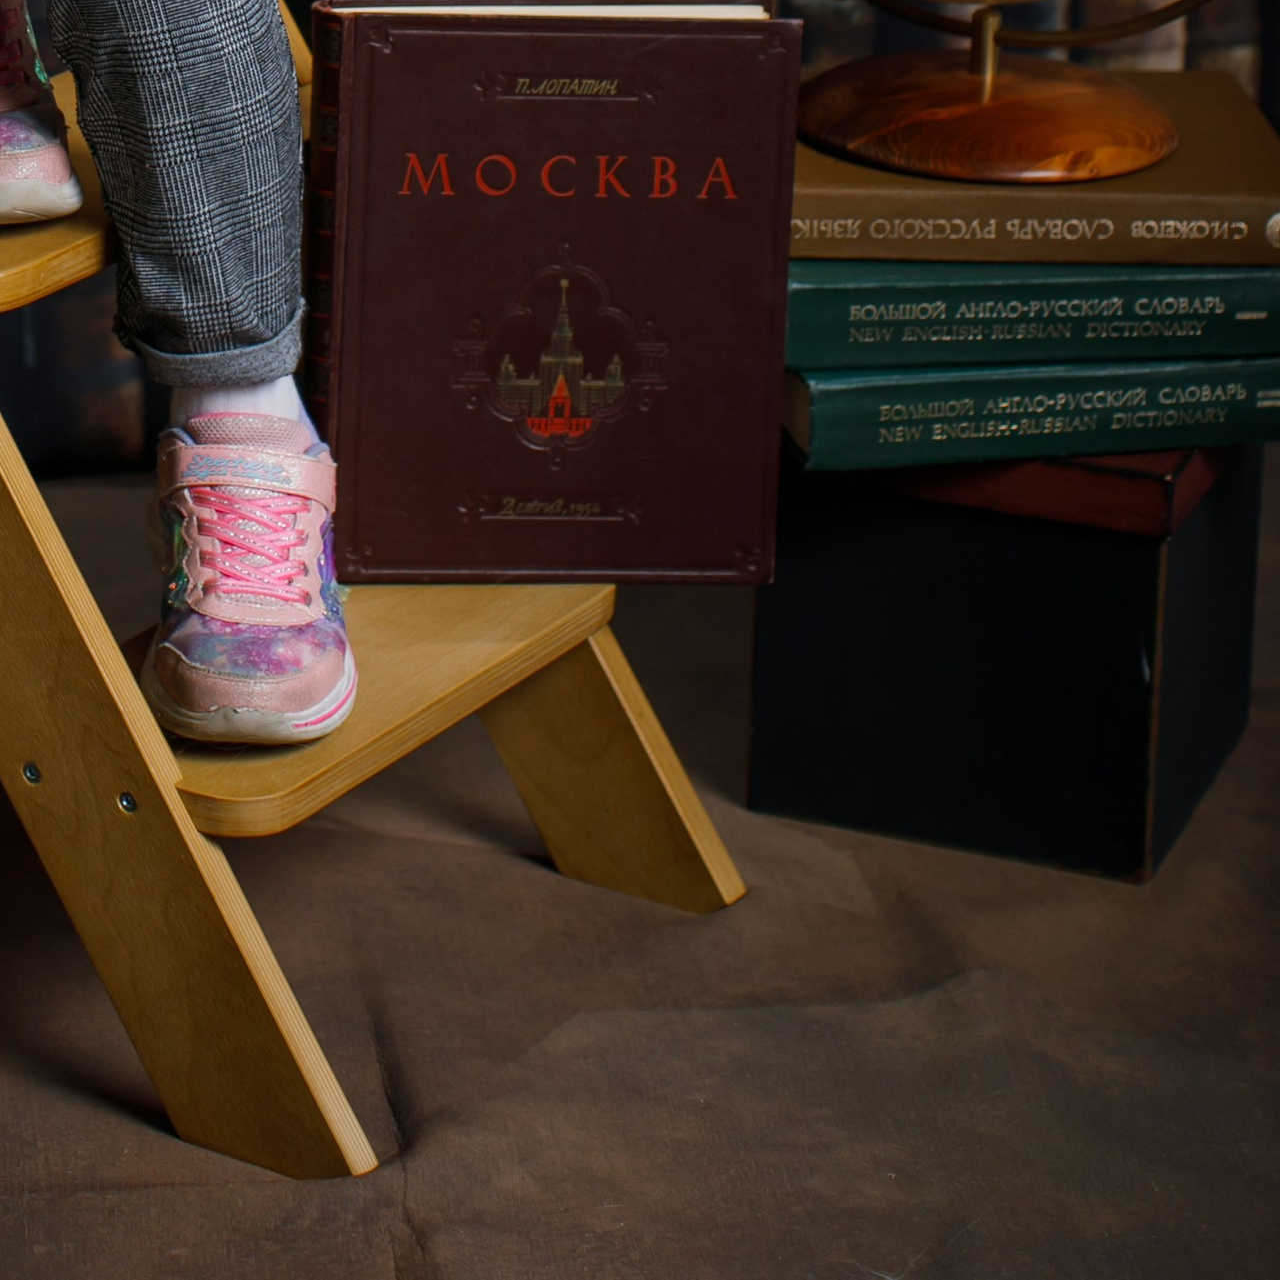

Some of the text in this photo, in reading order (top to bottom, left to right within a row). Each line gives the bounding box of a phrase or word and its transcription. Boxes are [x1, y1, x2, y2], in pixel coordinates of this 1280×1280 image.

[397, 150, 739, 200] МОСКВА
[790, 218, 863, 241] ЯЗЫК
[869, 218, 997, 241] РУССКОГО
[1006, 218, 1115, 241] СЛОВАРЬ
[848, 295, 1226, 322] БОЛЬШОЙ АНГЛО-РУССКИЙ СЛОВАРЬ
[848, 325, 893, 343] NEW
[1085, 319, 1208, 340] DICTIONARY
[878, 382, 1248, 423] БОЛЬШОЙ АНГЛО-РУССКИЙ СЛОВАРЬ
[877, 425, 923, 445] NEW
[1110, 406, 1229, 431] DICTIONARY
